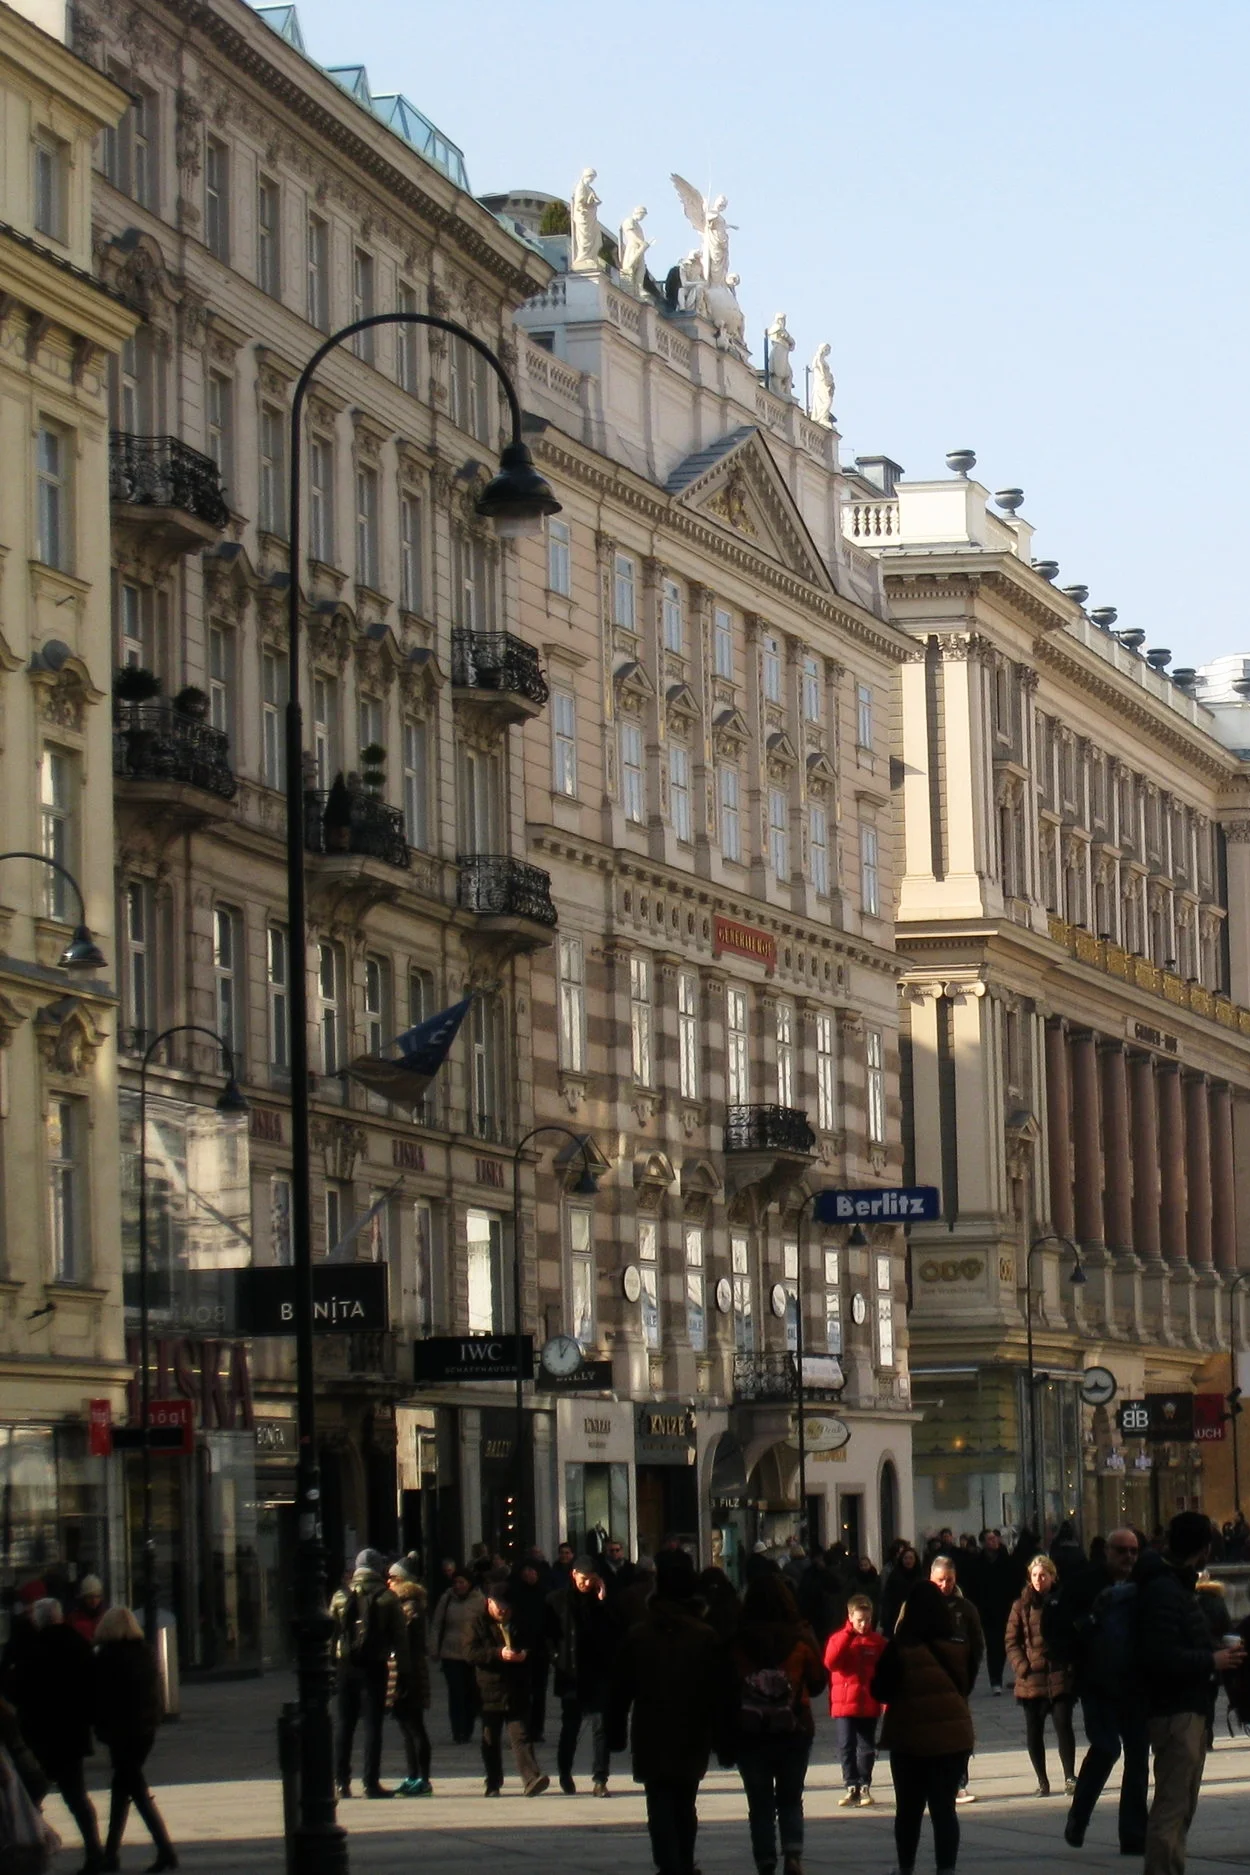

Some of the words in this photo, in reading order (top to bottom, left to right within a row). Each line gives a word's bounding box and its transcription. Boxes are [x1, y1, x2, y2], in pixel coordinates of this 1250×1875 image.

[836, 1192, 925, 1217] Berlitz
[280, 1296, 366, 1324] BNITA
[460, 1343, 503, 1361] IWC
[650, 1414, 686, 1436] KNIZE
